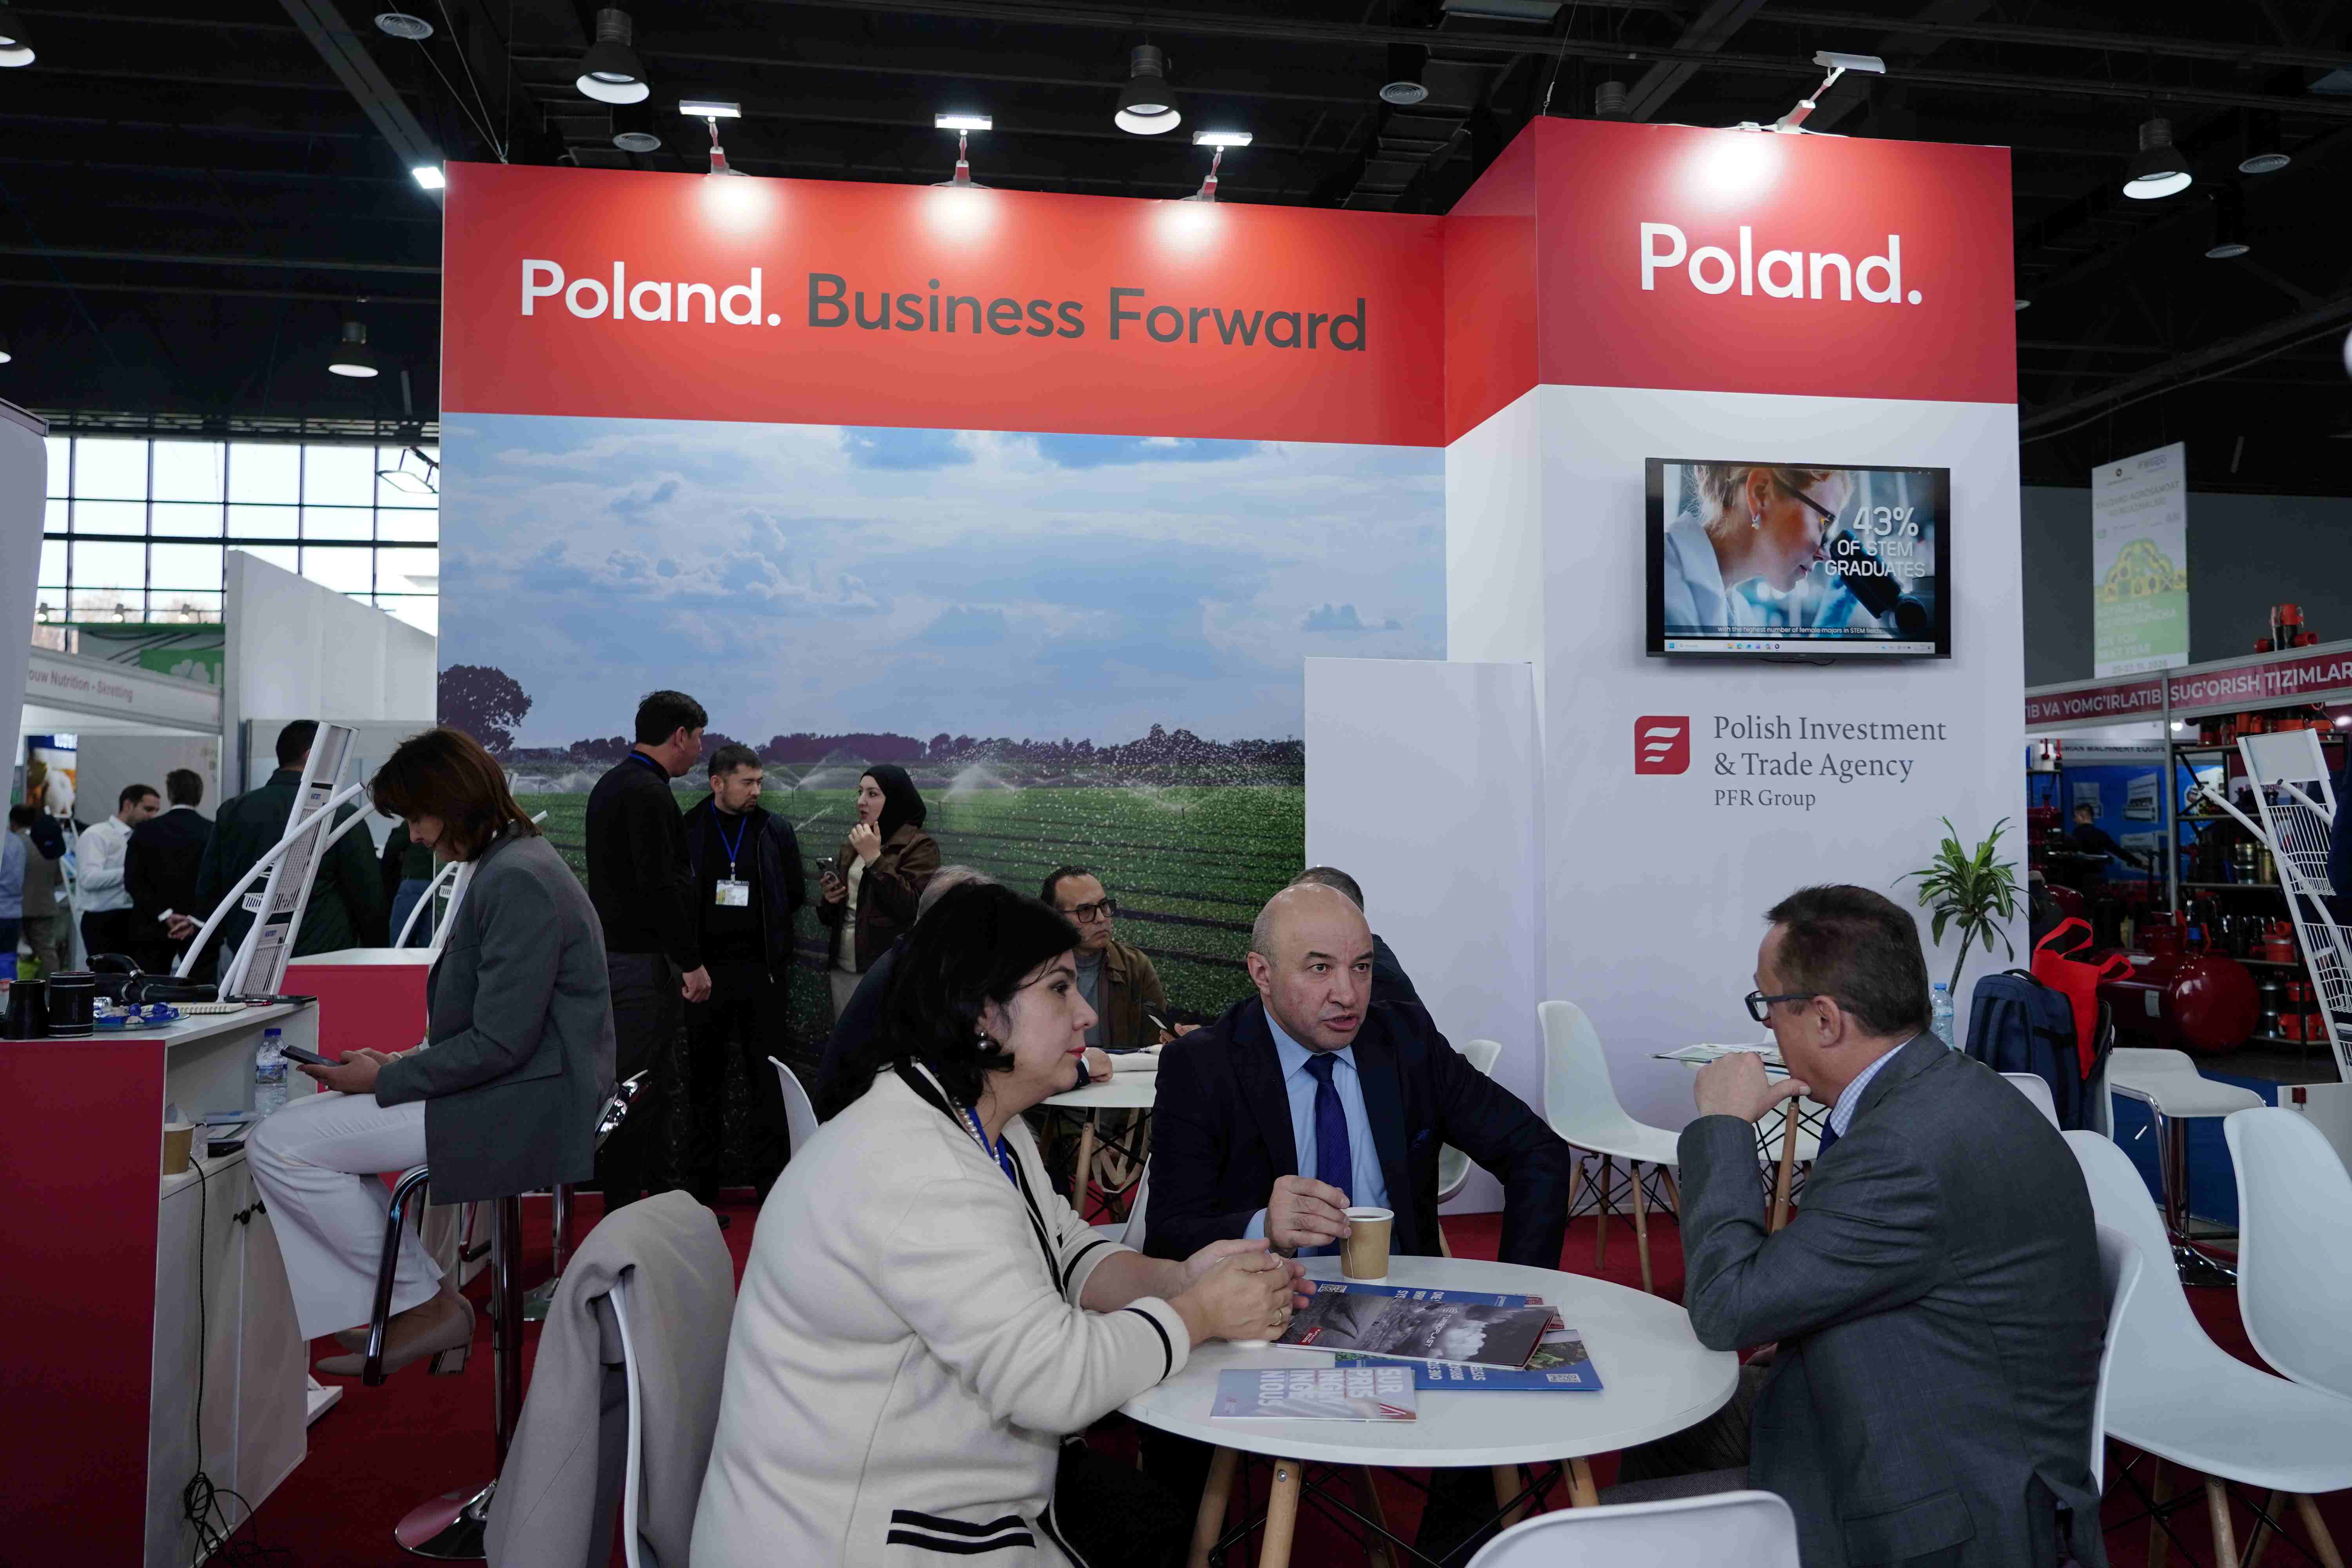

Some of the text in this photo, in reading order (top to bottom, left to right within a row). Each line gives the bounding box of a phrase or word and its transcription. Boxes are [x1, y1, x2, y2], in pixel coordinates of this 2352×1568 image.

[1641, 222, 1922, 305] Poland.
[522, 259, 1366, 352] Poland. Business Forward
[1853, 506, 1919, 537] 43%
[1837, 539, 1913, 557] OF STEM
[1825, 559, 1926, 577] GRADUATES
[1743, 626, 1766, 635] highest
[50, 671, 90, 691] Nutrition
[97, 679, 133, 703] Skretting
[2042, 702, 2060, 717] VA
[2062, 688, 2162, 714] YOMG'IRLATIB
[2170, 674, 2261, 702] SUG’ORISH
[2265, 661, 2352, 690] TIZIMLAR
[1714, 715, 1947, 740] Polish Investment
[1715, 751, 1914, 783] & Trade Agency
[1714, 789, 1816, 811] PFR Group
[1425, 1314, 1452, 1348] TURBOPLAST
[1258, 1370, 1285, 1407] NIOUS
[1289, 1369, 1314, 1399] INGE
[1348, 1368, 1373, 1398] PRIS
[1377, 1368, 1404, 1394] SUR
[1429, 1369, 1443, 1380] ONE
